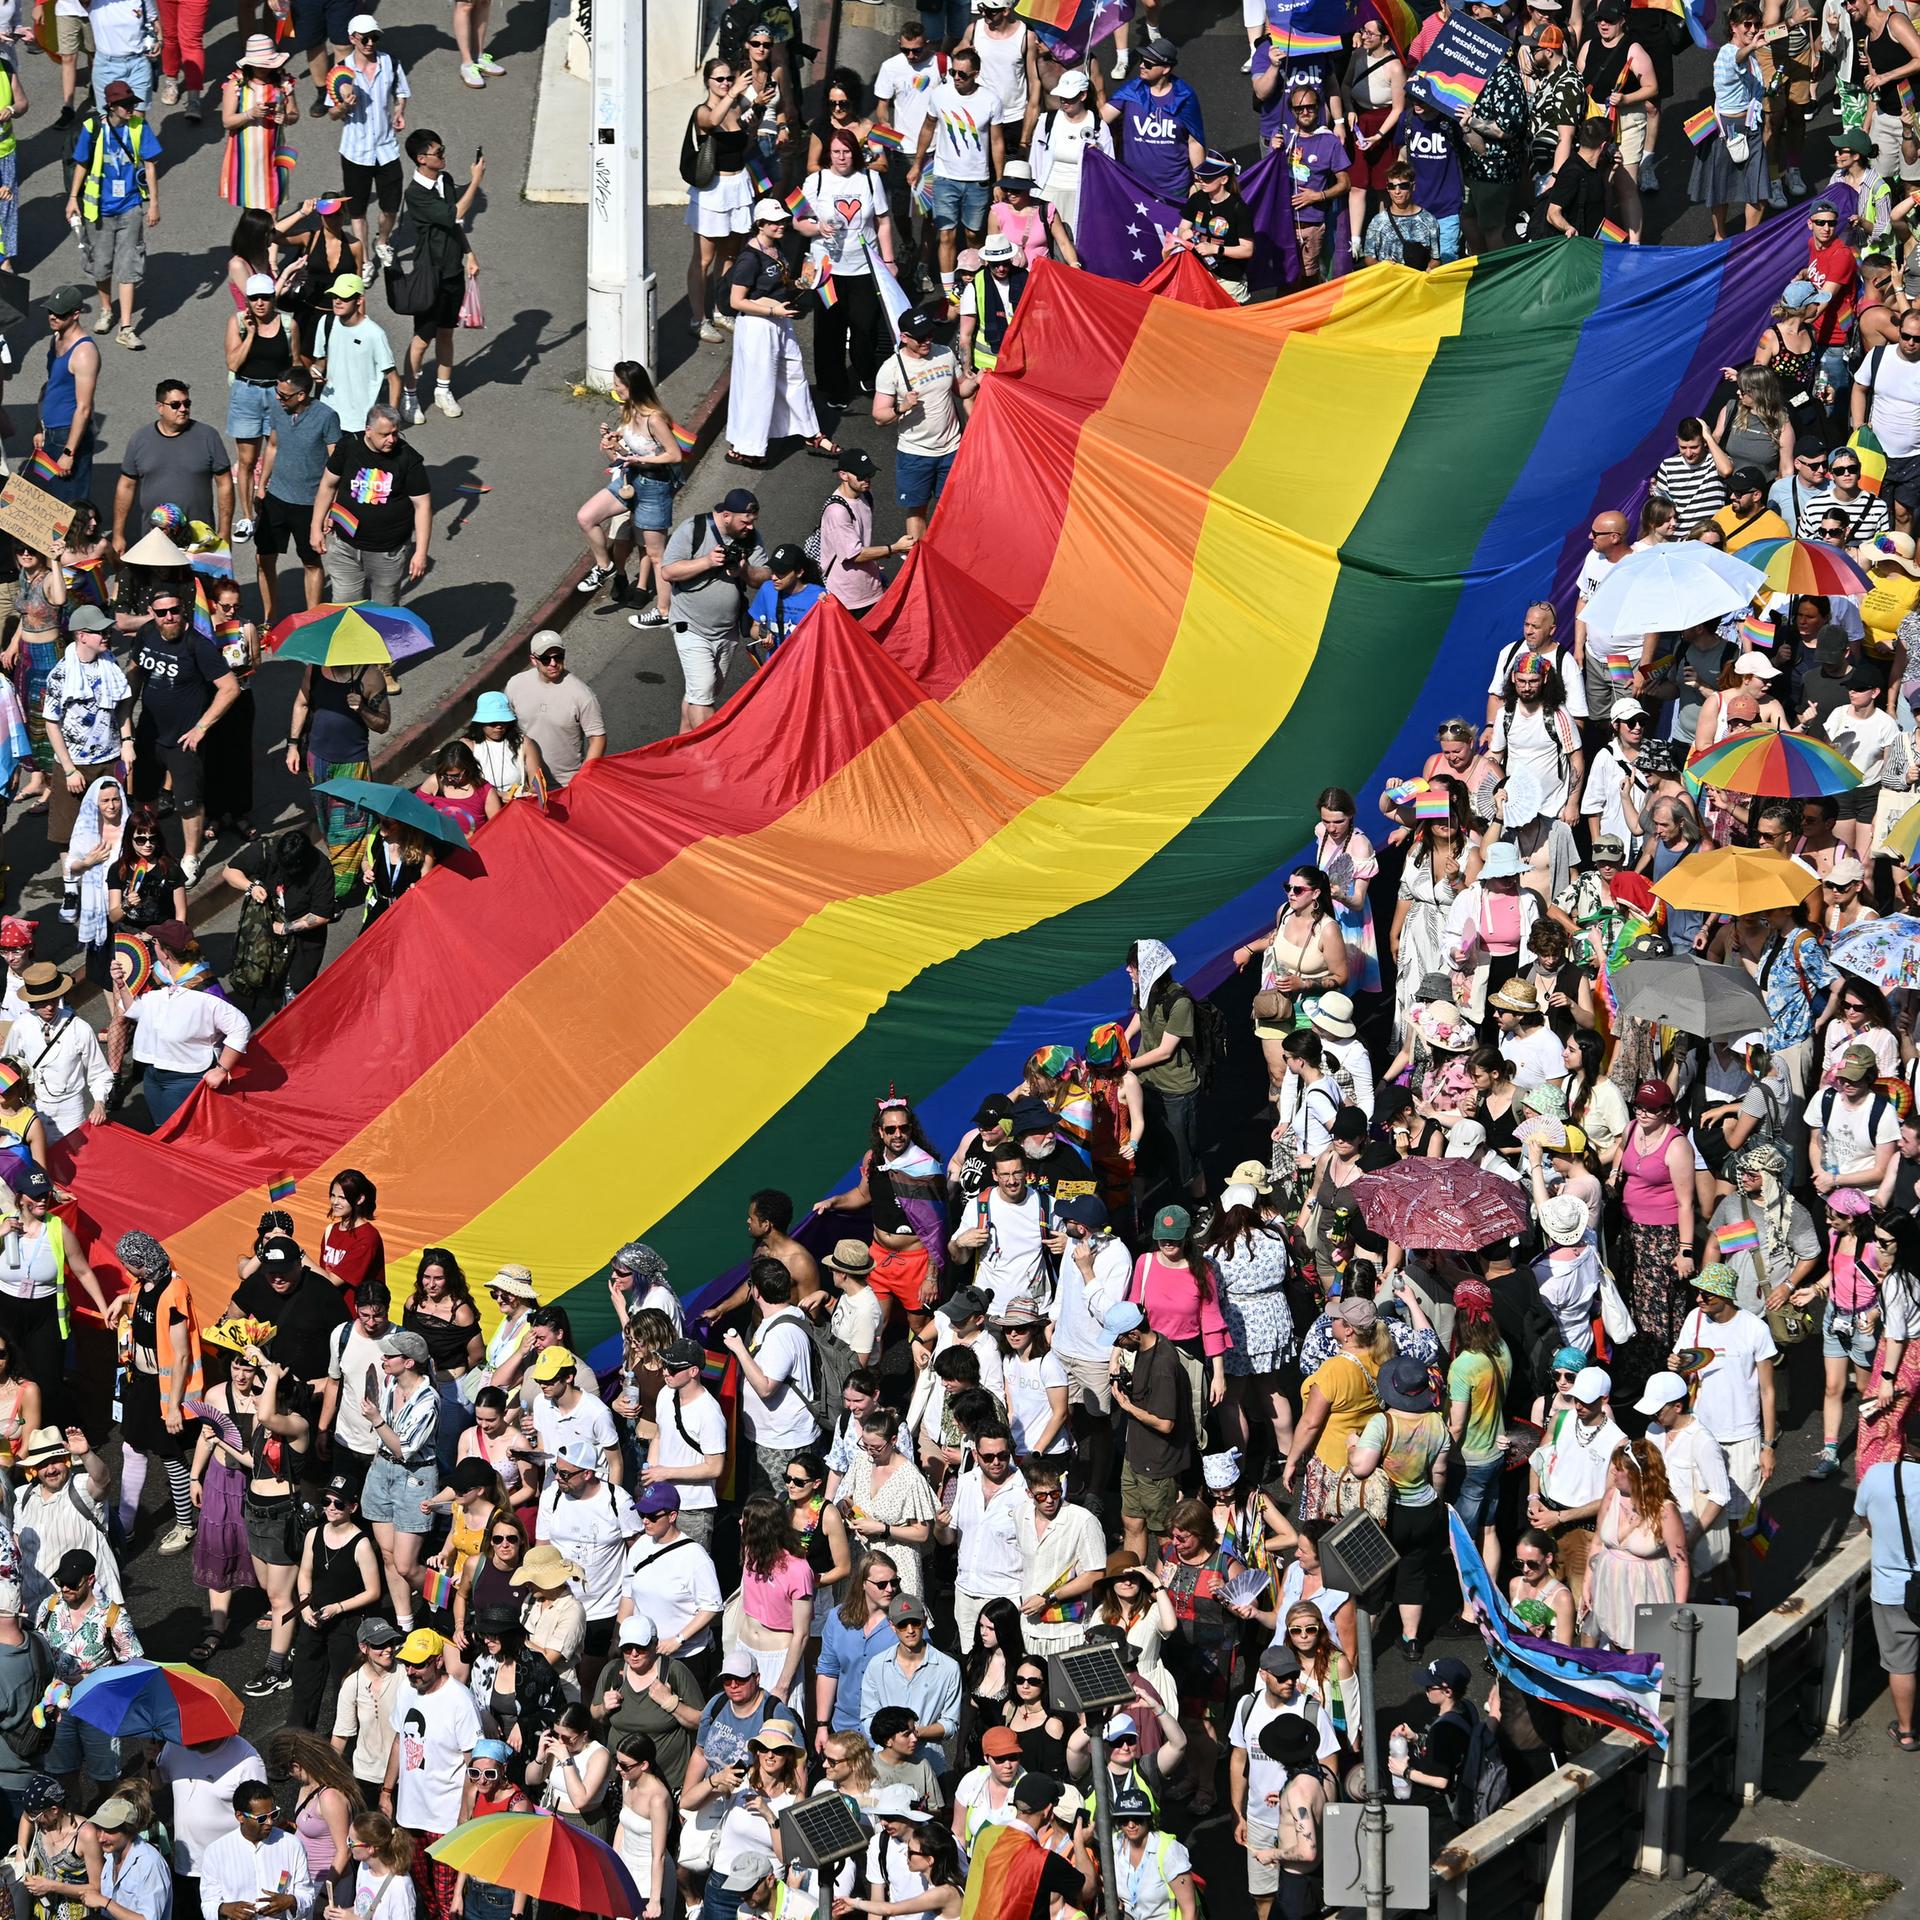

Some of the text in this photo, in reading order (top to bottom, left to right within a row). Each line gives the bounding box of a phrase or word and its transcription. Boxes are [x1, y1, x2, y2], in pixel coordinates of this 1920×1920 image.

[1448, 19, 1466, 35] Nem
[1472, 33, 1504, 56] szeretet
[1451, 34, 1489, 60] veszélyes!
[1279, 65, 1323, 87] Volt
[1475, 64, 1487, 76] az!
[1411, 83, 1427, 98] Volt
[1133, 107, 1176, 139] Volt
[350, 479, 393, 494] PRIDE
